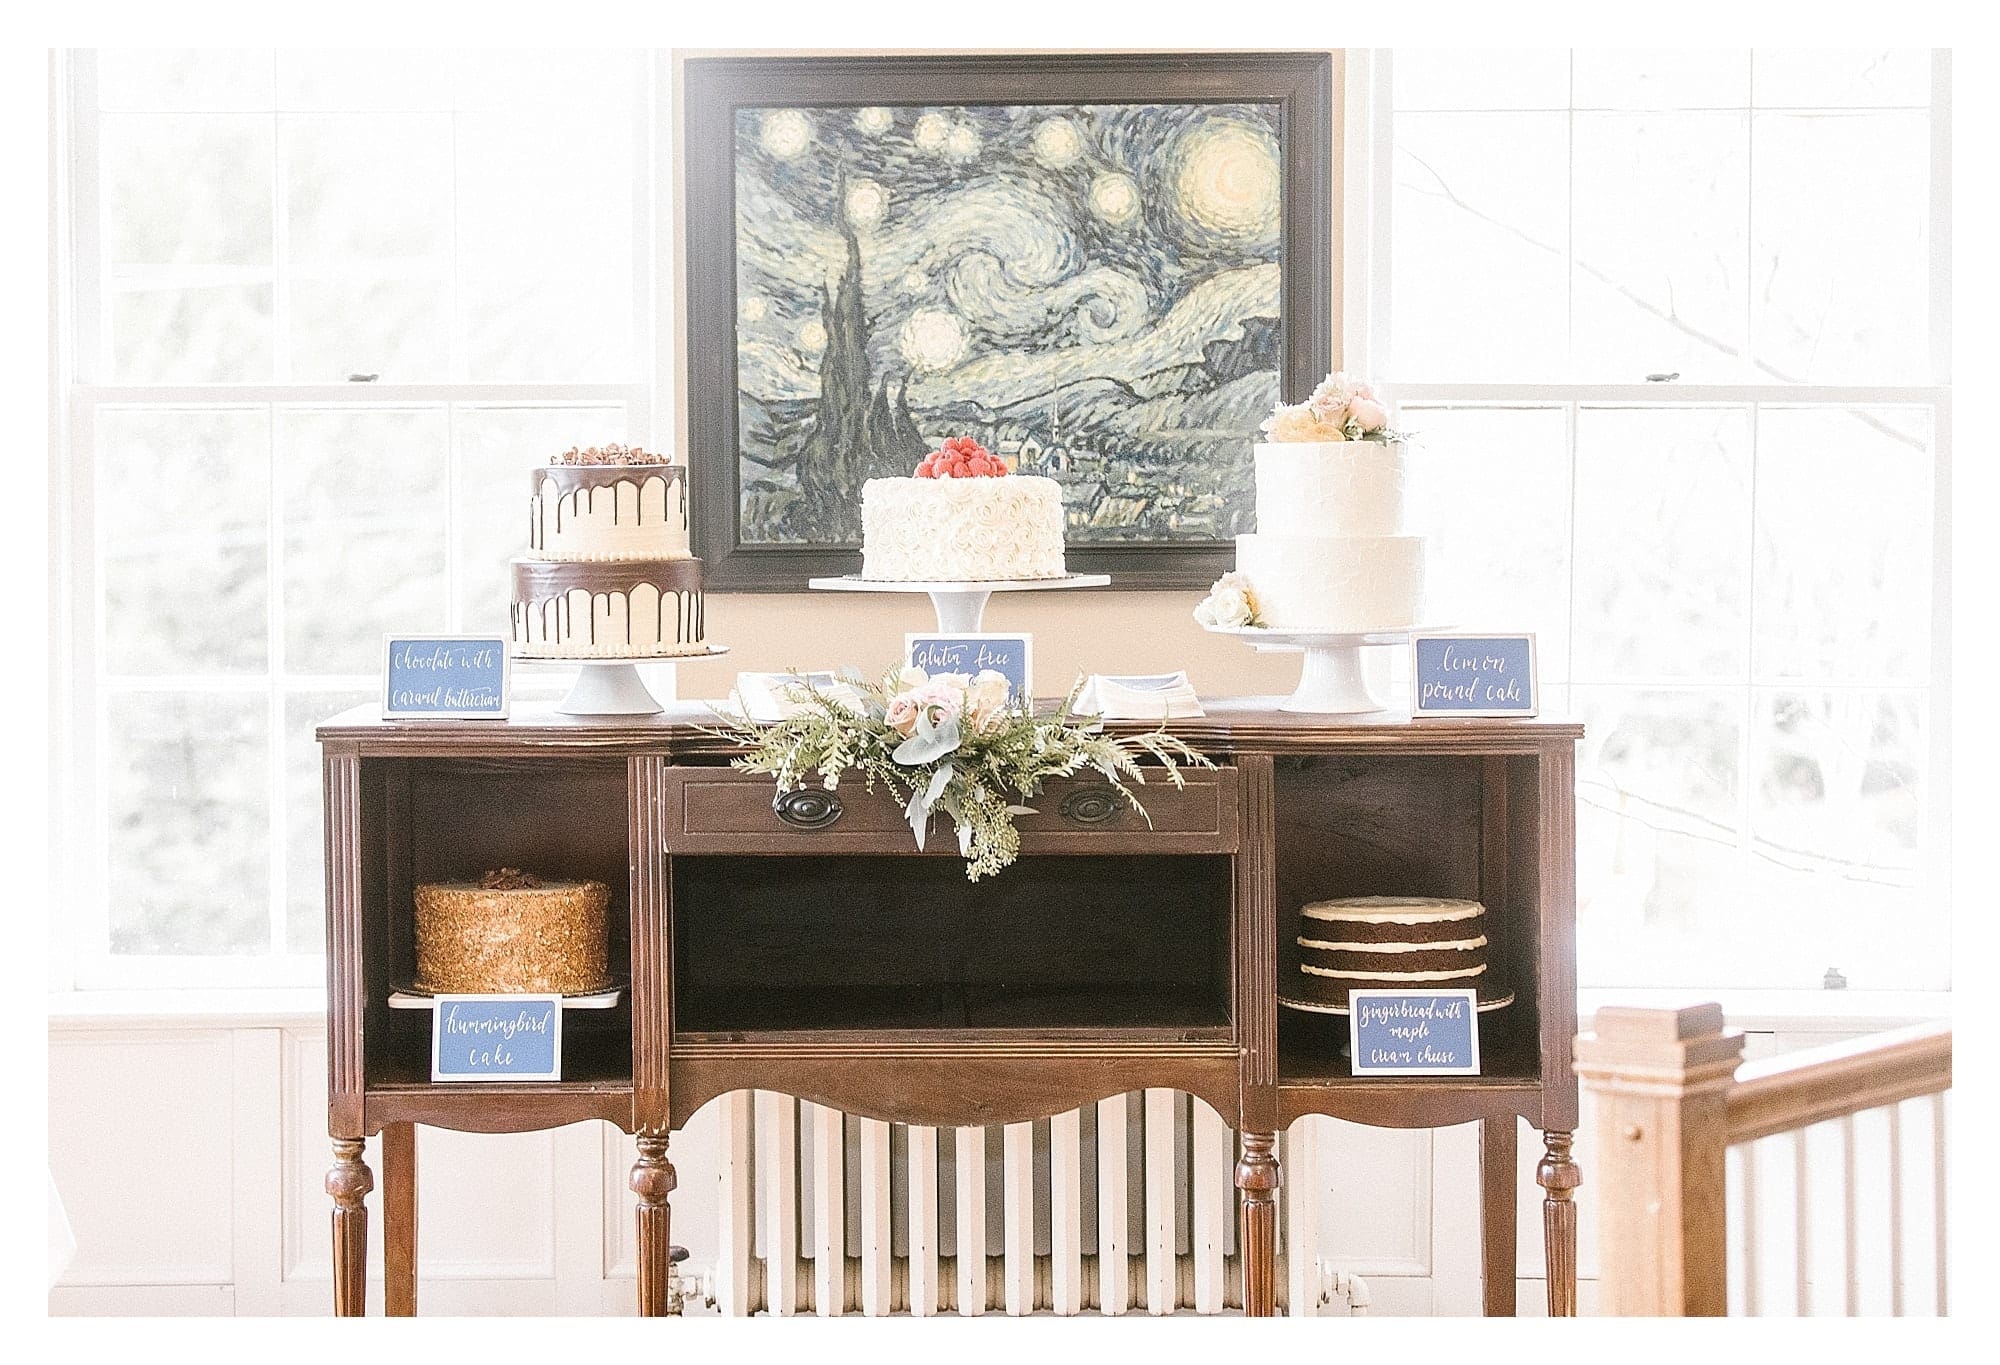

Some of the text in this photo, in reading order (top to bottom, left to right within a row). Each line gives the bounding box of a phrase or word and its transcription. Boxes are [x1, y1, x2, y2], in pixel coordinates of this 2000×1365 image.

[461, 648, 500, 669] with
[918, 644, 1009, 669] gluten free
[1437, 645, 1506, 673] lemon
[444, 686, 501, 708] buttercream
[1421, 677, 1521, 708] pound cake
[445, 1004, 551, 1040] hummingbird
[1360, 998, 1470, 1027] gingerbread with
[1390, 1020, 1430, 1043] maple
[469, 1043, 514, 1067] cake
[1371, 1044, 1456, 1064] cream cheese
